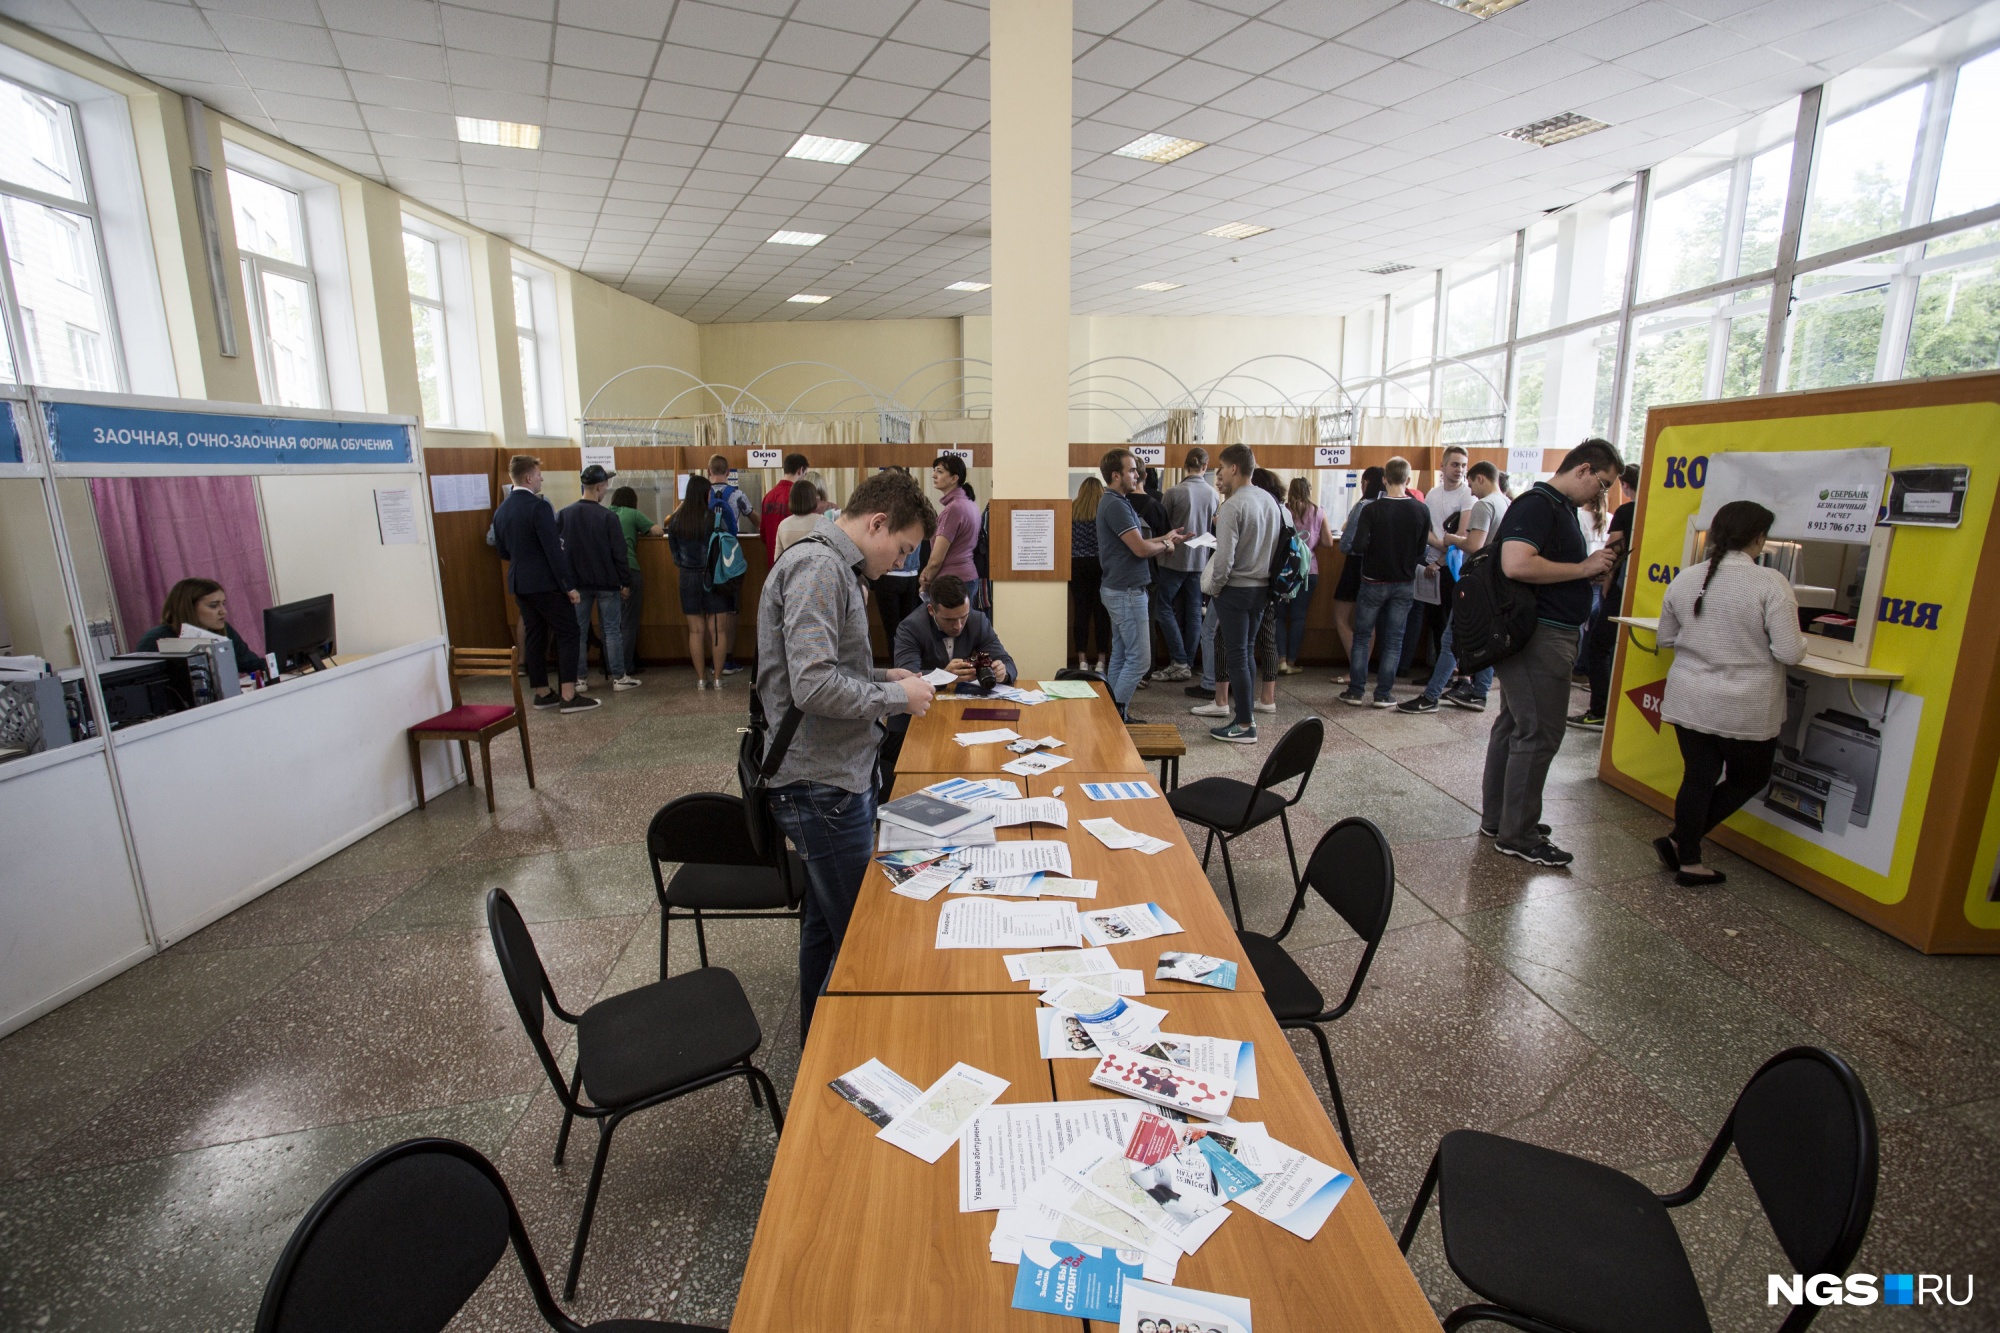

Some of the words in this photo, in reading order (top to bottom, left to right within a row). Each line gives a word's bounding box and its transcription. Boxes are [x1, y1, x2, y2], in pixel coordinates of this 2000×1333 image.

[93, 427, 183, 449] ЗАОЧНАЯ,
[187, 432, 297, 450] ОЧНО-ЗАОЧНАЯ
[300, 437, 339, 450] ФОРМА
[341, 438, 393, 451] ОБУЧЕНИЯ
[752, 450, 777, 458] Окно
[1134, 447, 1160, 455] Окно
[1320, 448, 1345, 456] Окно
[763, 459, 769, 467] 7
[1144, 456, 1150, 464] 9
[1327, 456, 1339, 465] 10
[1520, 462, 1528, 470] 11
[1664, 455, 1709, 489] КО
[1830, 490, 1869, 499] СБЕРБАНК
[1817, 502, 1867, 511] БЕЗНАЛИЧНЫЙ
[1826, 511, 1851, 519] РАСЧЕТ
[1807, 521, 1812, 529] 8
[1813, 521, 1827, 530] 913
[1829, 522, 1843, 532] 706
[1844, 523, 1855, 532] 67
[1856, 524, 1867, 533] 33
[1642, 693, 1660, 713] ВХ
[974, 1160, 982, 1201] Уважаемые
[1219, 1165, 1247, 1189] ГАРАЖ
[1263, 1157, 1295, 1193] ИНОСТРНЫХ
[1258, 1184, 1284, 1215] СТУДЕНТОВ
[1058, 1255, 1074, 1281] БЫТЬ
[1039, 1270, 1050, 1298] Знаешь
[1065, 1253, 1086, 1311] СТУДЕНТОМ
[1055, 1282, 1065, 1303] КАК
